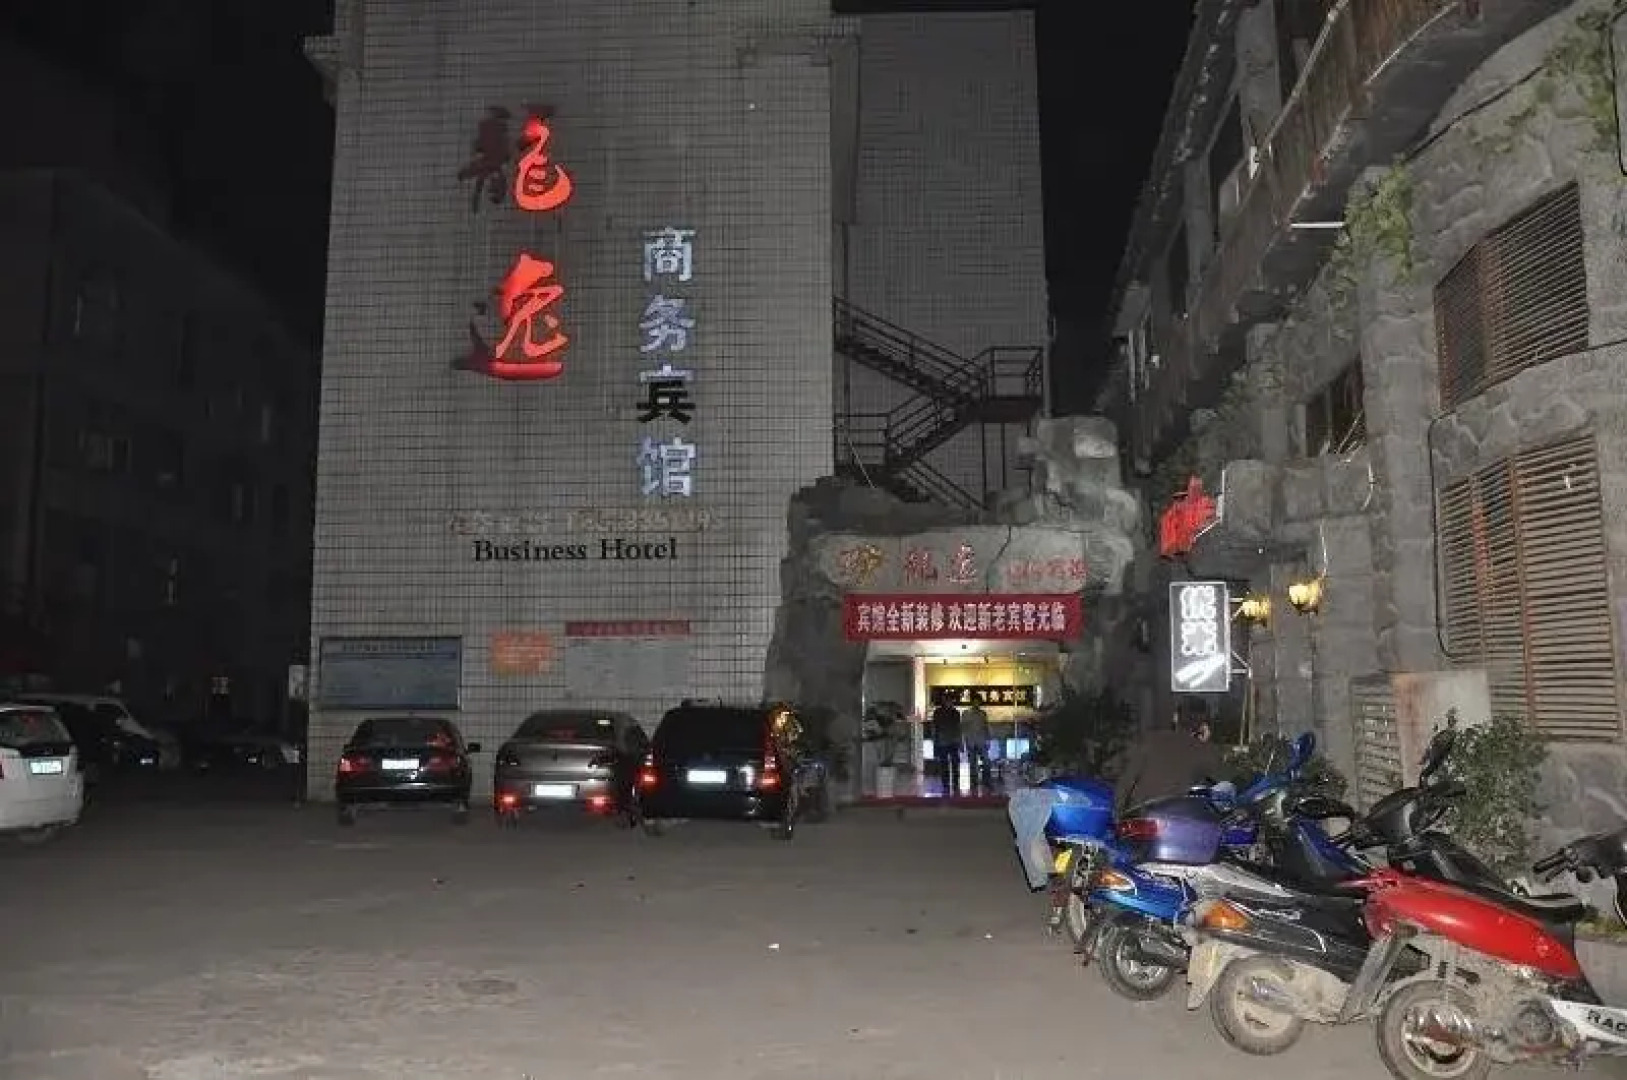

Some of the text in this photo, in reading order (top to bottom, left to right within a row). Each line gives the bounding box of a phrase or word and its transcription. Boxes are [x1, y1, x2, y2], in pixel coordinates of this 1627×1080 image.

[636, 227, 698, 498] 商务宾馆
[473, 537, 678, 562] Business Hotel
